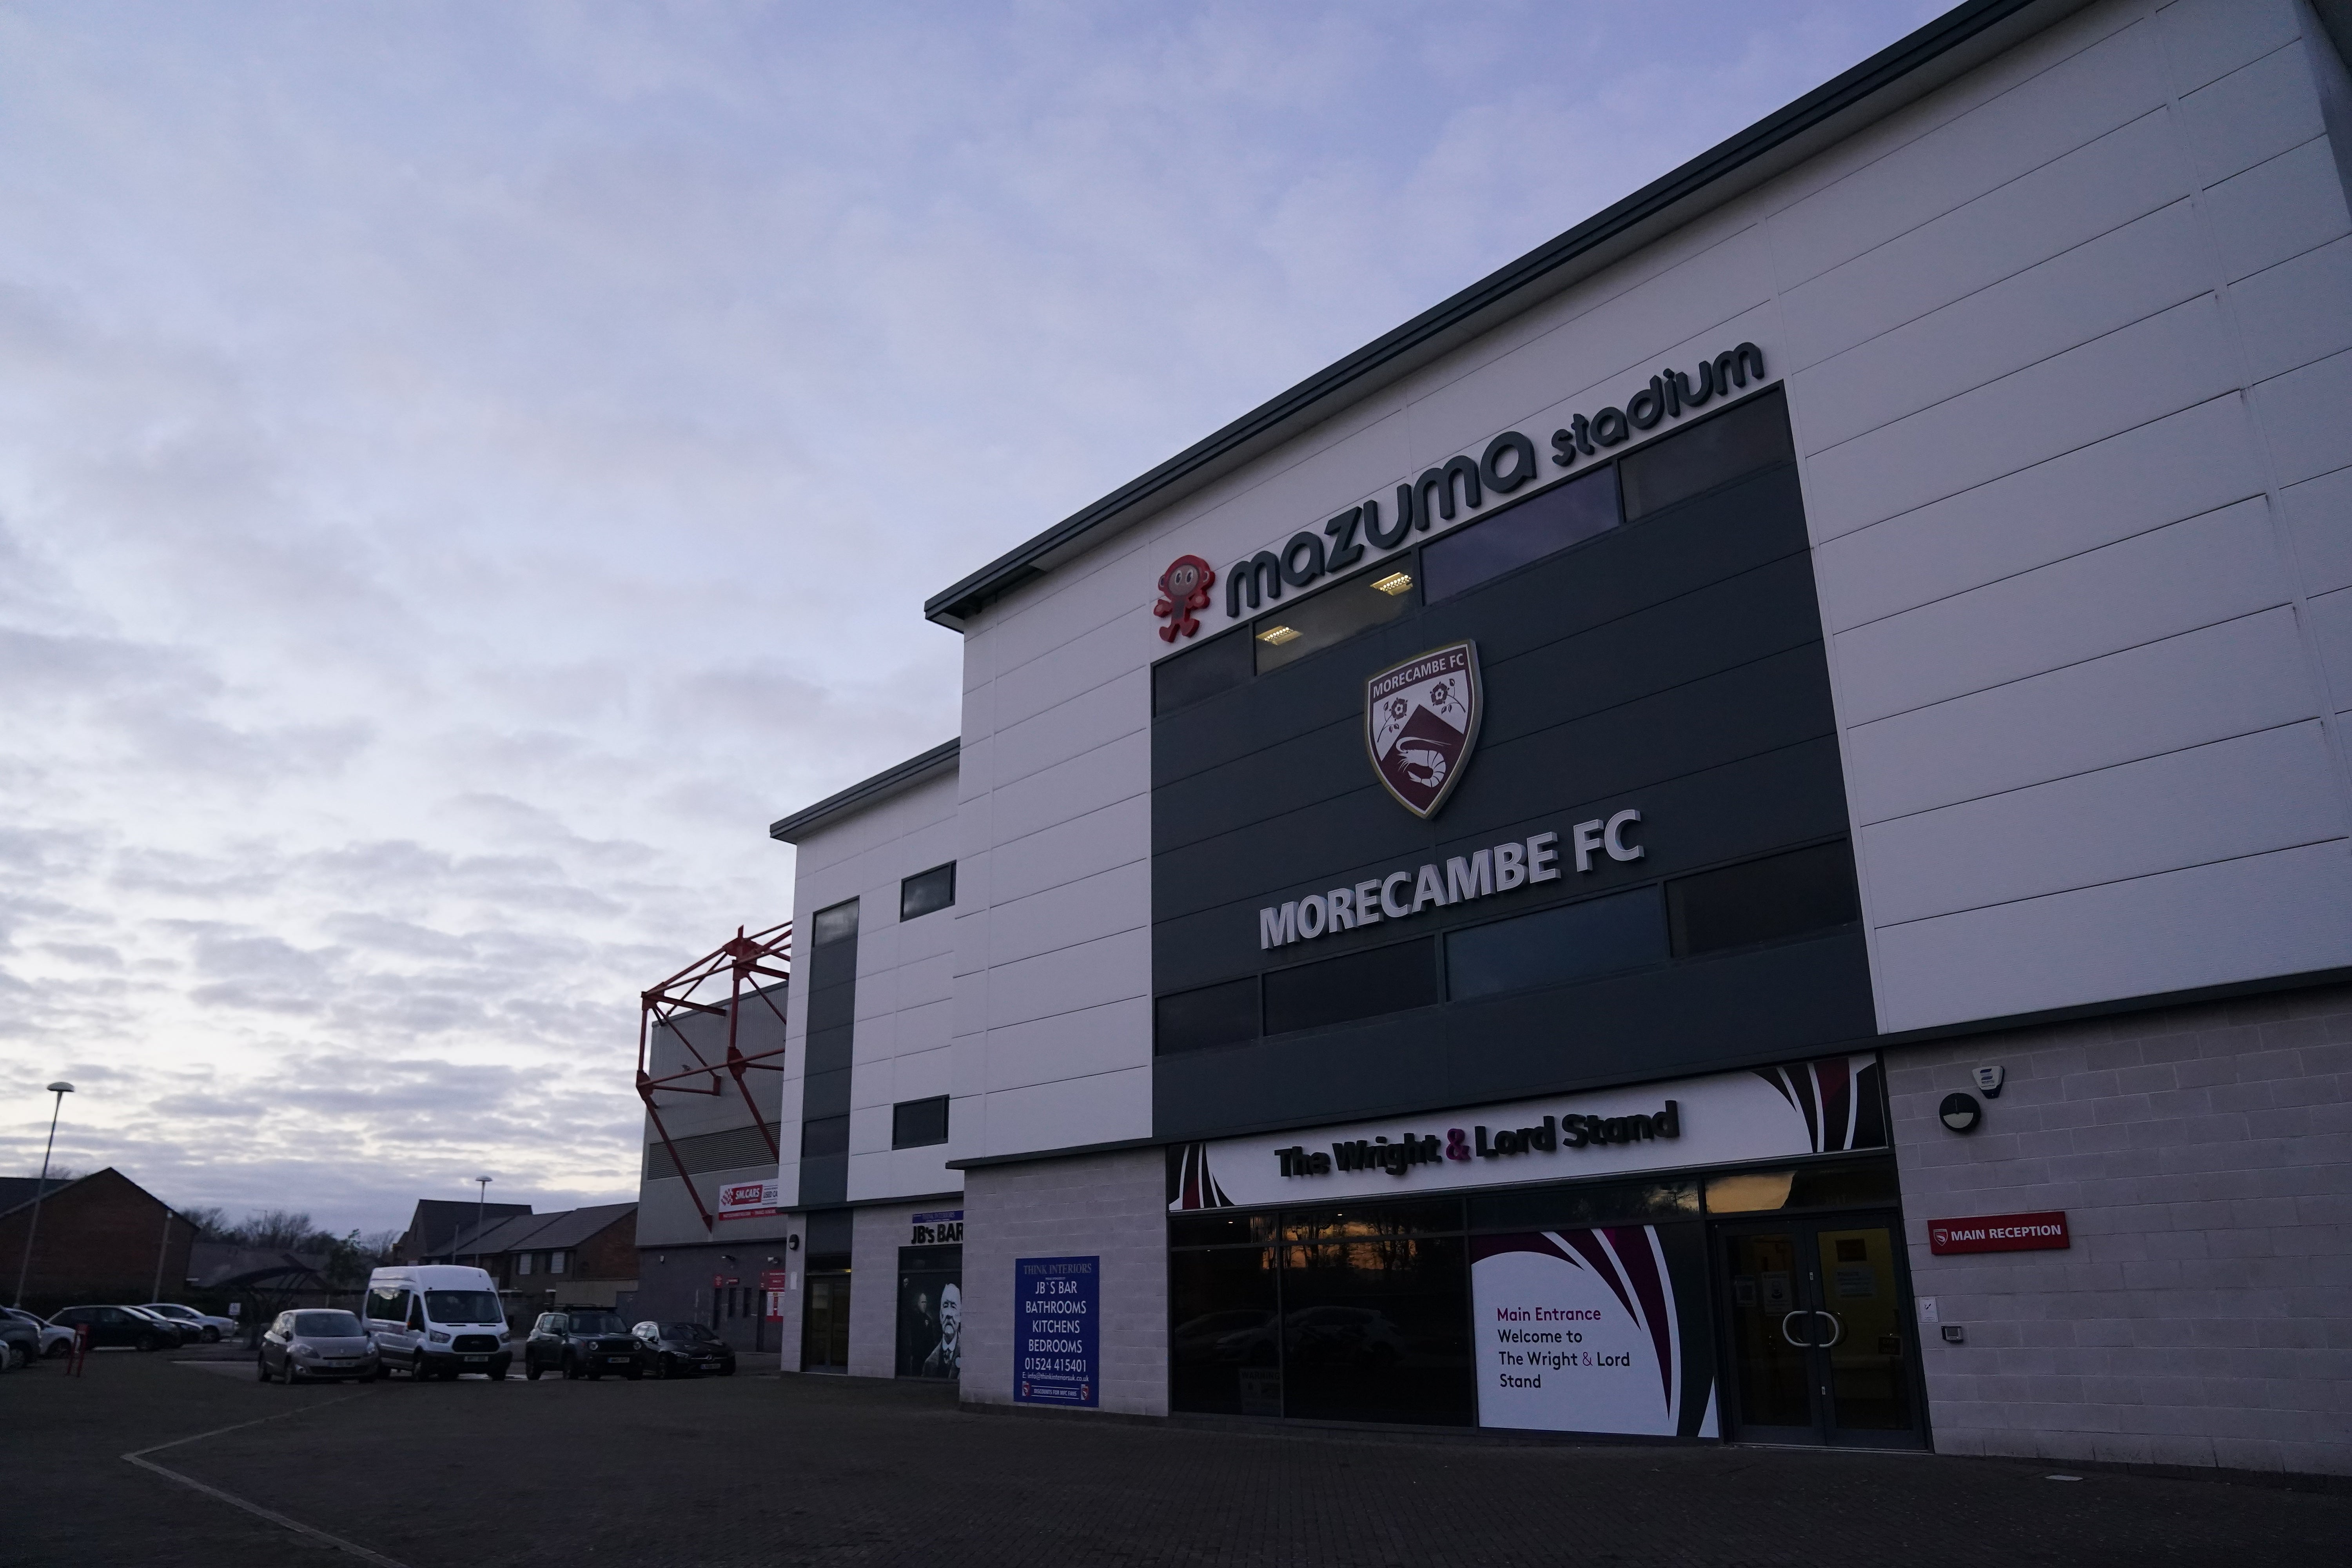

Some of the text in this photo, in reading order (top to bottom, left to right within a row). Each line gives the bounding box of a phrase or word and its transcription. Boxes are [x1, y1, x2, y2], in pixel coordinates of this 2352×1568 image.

[1226, 342, 1764, 618] mazuma stadium
[1373, 653, 1464, 698] MORECAMBE FC
[1259, 809, 1645, 951] MORECAMBE FC
[1274, 1100, 1681, 1177] The Wright & Lord Stand
[911, 1223, 963, 1244] JB's BAR
[1951, 1225, 2062, 1241] MAIN RECEPTION
[1024, 1263, 1092, 1274] THINK INTERIORS
[1059, 1281, 1077, 1294] BAR
[1026, 1300, 1086, 1314] BATHROOMS
[1497, 1307, 1601, 1321] Main Entrance
[1033, 1320, 1080, 1333] KITCHENS
[1497, 1329, 1583, 1343] Welcome to
[1028, 1339, 1082, 1353] BEDROOMS
[1025, 1357, 1086, 1372] 01524 415401
[1499, 1351, 1630, 1370] The Wright & Lord
[1242, 1371, 1280, 1380] WARNING
[1500, 1374, 1541, 1388] Stand
